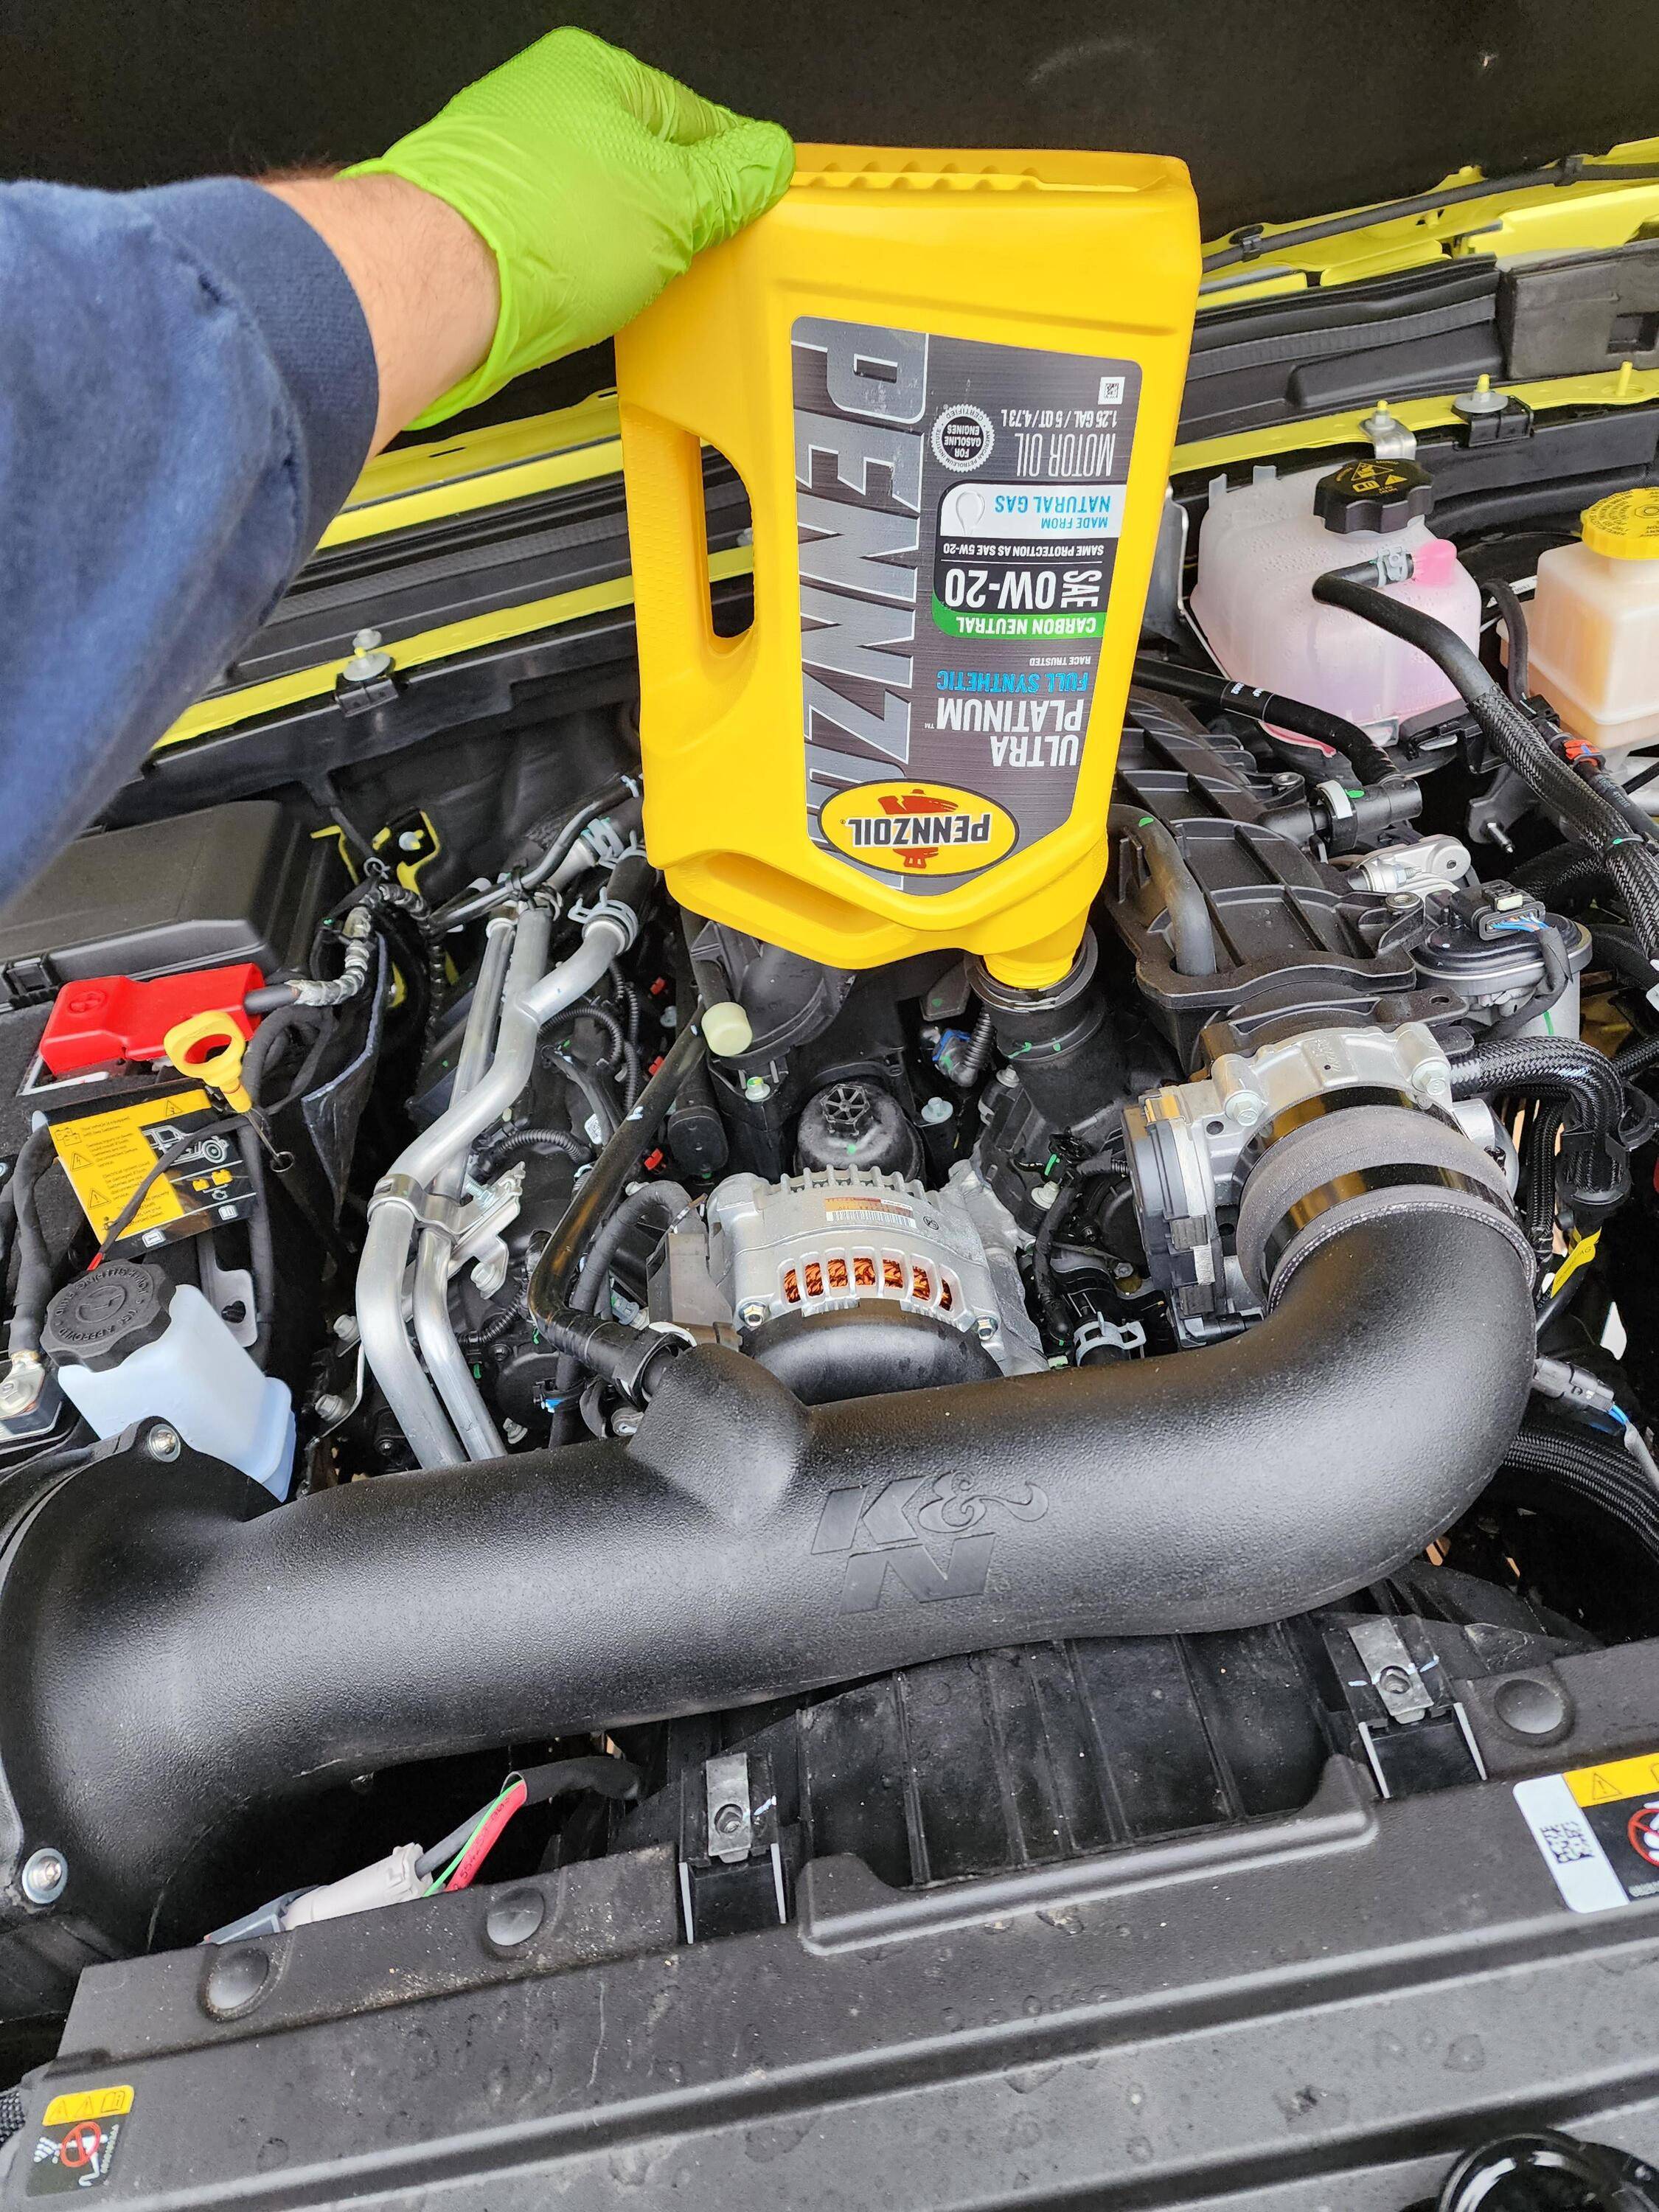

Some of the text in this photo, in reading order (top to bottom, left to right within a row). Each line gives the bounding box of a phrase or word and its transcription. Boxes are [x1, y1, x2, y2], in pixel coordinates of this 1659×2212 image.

[946, 408, 983, 421] CERTIFIED
[1055, 411, 1062, 427] 5
[1074, 410, 1093, 428] GAL
[1096, 410, 1117, 428] 1.25
[947, 425, 979, 436] ENGINES
[936, 429, 990, 467] AMERICAN PETROLEUM INSTITUTE
[945, 436, 981, 447] GASOLINE
[955, 448, 970, 458] FOR
[1015, 433, 1116, 477] MOTOR OIL
[995, 495, 1110, 512] NATURAL GAS
[1041, 518, 1108, 529] MADE FROM
[943, 543, 1104, 556] SAME PROTECTION AS SAE 5W-20
[945, 568, 1102, 609] SAE 0W-20
[956, 617, 1096, 635] CARBON NEUTRAL
[1029, 656, 1091, 667] RACE TRUSTED
[936, 671, 1088, 694] FULL SYNTHETIC
[990, 735, 1079, 767] ULTRA
[847, 814, 990, 846] PENNZOIL
